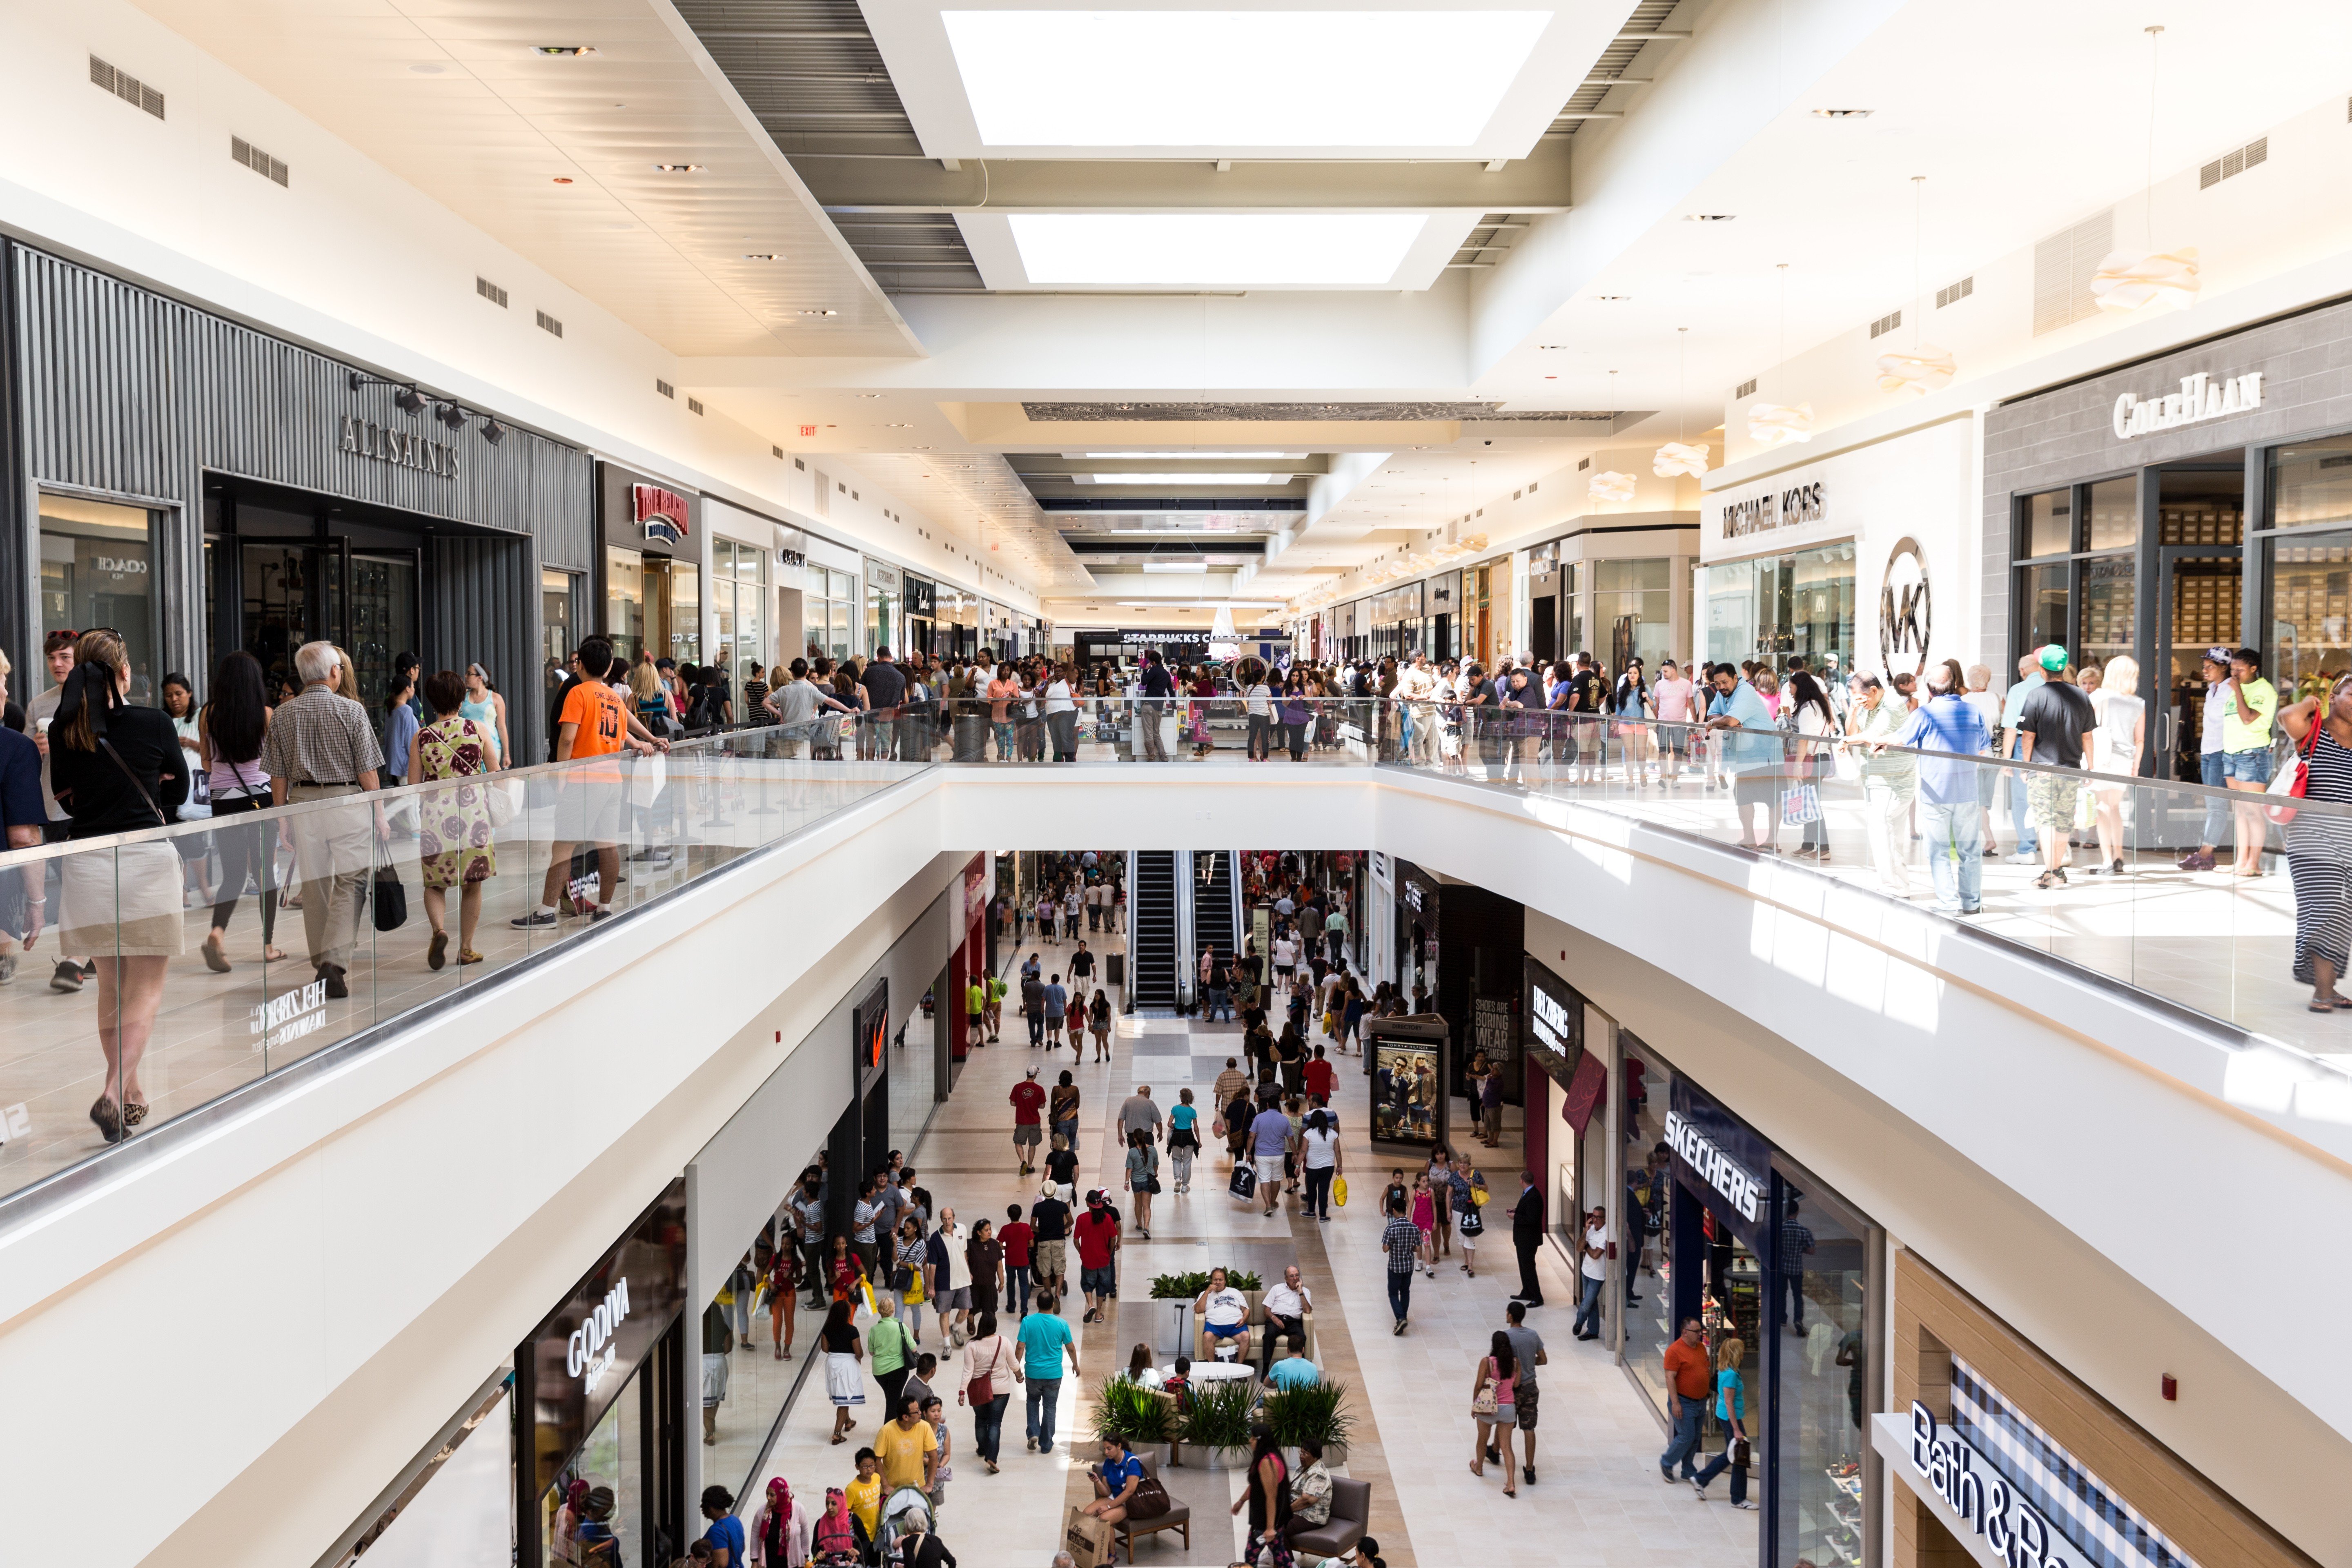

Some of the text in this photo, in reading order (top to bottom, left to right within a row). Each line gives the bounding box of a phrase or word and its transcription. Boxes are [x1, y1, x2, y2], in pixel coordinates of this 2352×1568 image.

[801, 427, 815, 437] EXIT
[340, 414, 460, 479] ALLSAINTS
[641, 486, 689, 535] TRUE RELIGION
[1723, 482, 1826, 539] MICHAEL KORS
[1530, 559, 1550, 576] COACH
[1388, 597, 1399, 616] GUCCI
[595, 692, 621, 704] SNEJDER
[599, 702, 618, 739] 10
[1475, 998, 1508, 1014] SHOES ARE
[1533, 985, 1568, 1038] HELZBERG
[1475, 1011, 1508, 1031] BORING
[1475, 1027, 1508, 1049] WEAR
[1533, 1016, 1566, 1058] DIAMONDS OUTLET
[1475, 1046, 1509, 1061] EAKERS
[1664, 1111, 1759, 1223] SKECHERS
[567, 1277, 630, 1378] GODIVA
[1911, 1399, 2069, 1568] Bath & B
[1071, 1523, 1082, 1535] the
[1069, 1543, 1082, 1556] store
[1070, 1533, 1087, 1548] outlet
